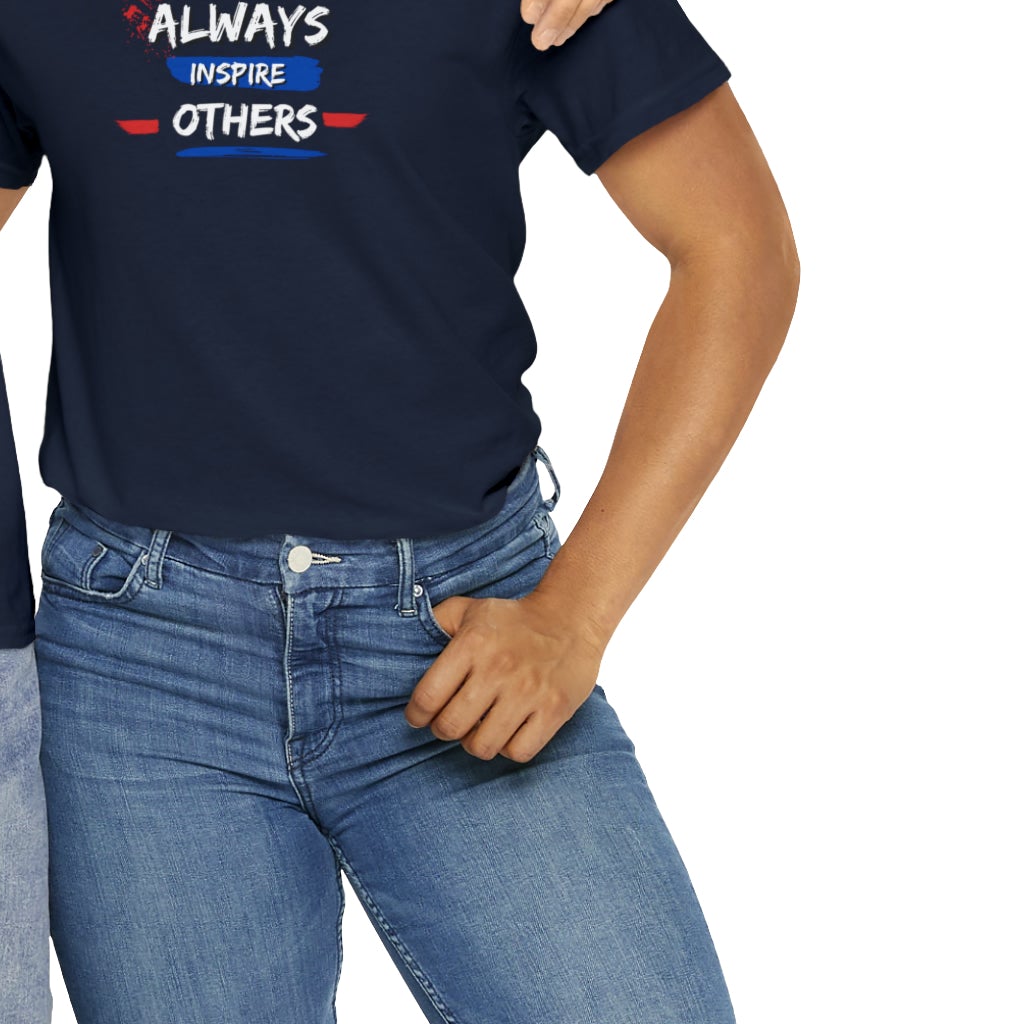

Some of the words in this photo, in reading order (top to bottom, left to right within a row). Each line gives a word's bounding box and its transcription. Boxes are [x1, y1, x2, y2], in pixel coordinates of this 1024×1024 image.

[147, 1, 330, 50] ALWAYS
[189, 61, 286, 88] INSPIRE
[172, 102, 318, 143] OTHERS
